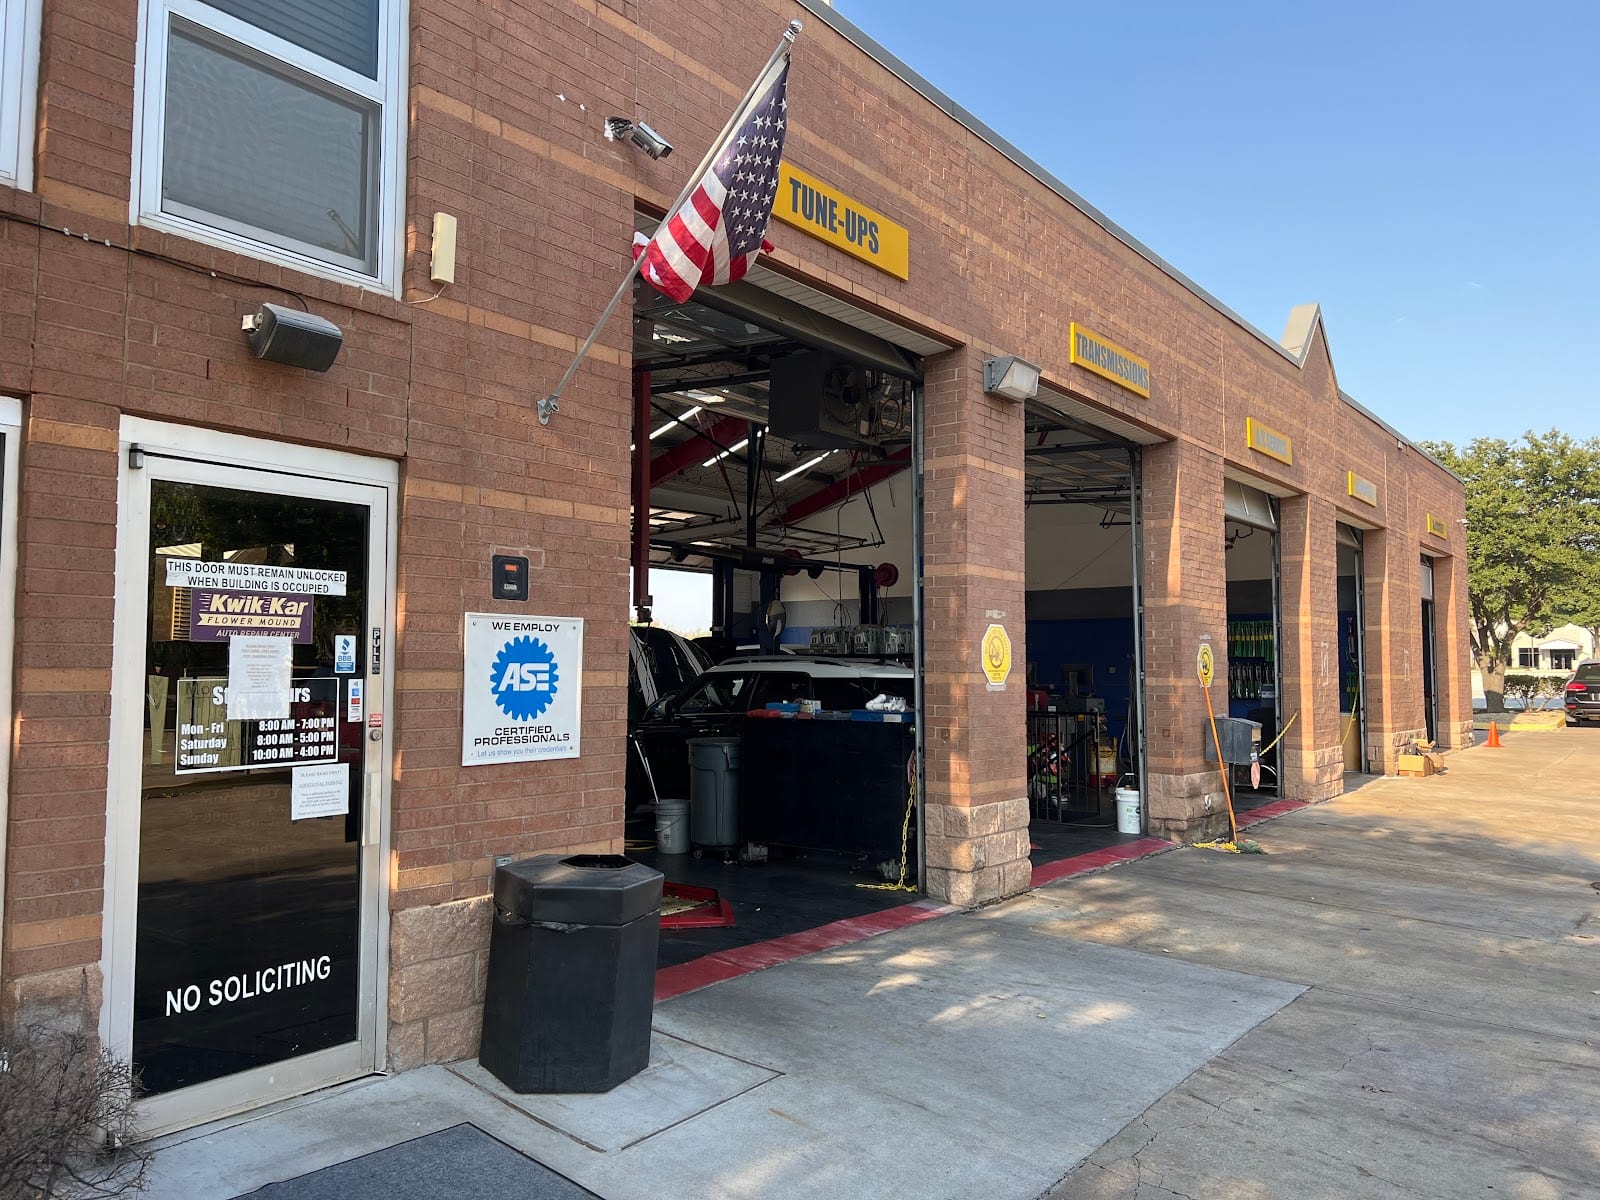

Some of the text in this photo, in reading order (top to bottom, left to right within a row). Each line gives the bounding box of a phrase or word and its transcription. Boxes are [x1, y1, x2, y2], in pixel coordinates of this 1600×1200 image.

[789, 177, 879, 254] TUNE-UPS
[1076, 332, 1148, 390] TRANSMISSIONS
[168, 561, 346, 583] THIS DOOR MUST REMAIN UNLOCKED
[188, 576, 329, 594] WHEN BUILDING IS OCCUPIED
[209, 593, 309, 616] Kwik Kar
[207, 617, 296, 627] FLOWER MOUND
[491, 621, 560, 633] WE EMPLOY
[216, 629, 238, 637] AUTO
[270, 630, 300, 639] CENTER
[498, 662, 550, 692] ASE
[181, 723, 204, 736] Mon
[211, 722, 224, 734] Fri
[258, 719, 280, 732] 8:00
[280, 719, 295, 731] AM
[301, 718, 320, 729] 7:00
[321, 717, 335, 729] PM
[494, 725, 552, 736] CERTIFIED
[180, 736, 227, 751] Saturday
[256, 733, 278, 746] 8:00
[279, 732, 294, 744] AM
[300, 732, 320, 743] 5:00
[320, 731, 335, 742] PM
[474, 733, 570, 747] PROFESSIONALS
[180, 752, 219, 766] Sunday
[252, 748, 278, 760] 10:00
[279, 747, 294, 759] AM
[300, 746, 320, 757] 4:00
[320, 745, 334, 756] PM
[477, 749, 487, 757] Let
[513, 749, 523, 757] you
[166, 955, 331, 1017] NO SOLICITING
